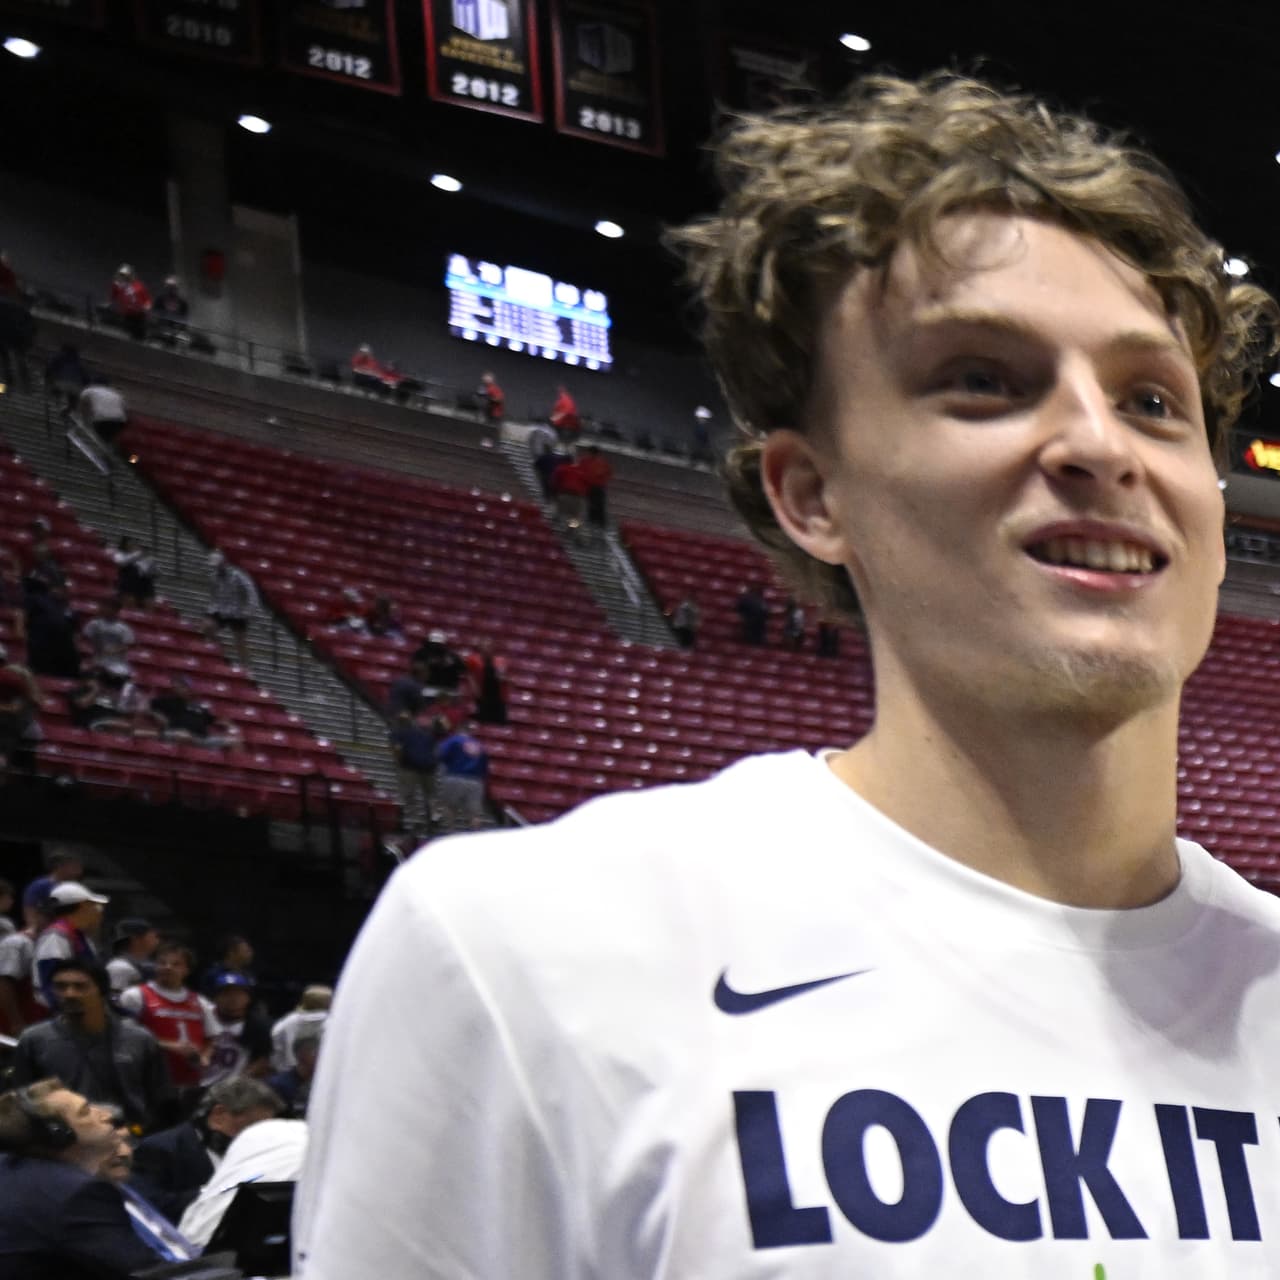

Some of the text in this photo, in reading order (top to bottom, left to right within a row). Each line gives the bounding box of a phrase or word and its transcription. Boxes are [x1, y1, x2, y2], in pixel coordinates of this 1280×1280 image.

[308, 44, 371, 79] 2012
[452, 73, 519, 106] 2012
[579, 107, 641, 140] 2013
[732, 1088, 1150, 1251] LOCK
[1153, 1102, 1262, 1243] IT
